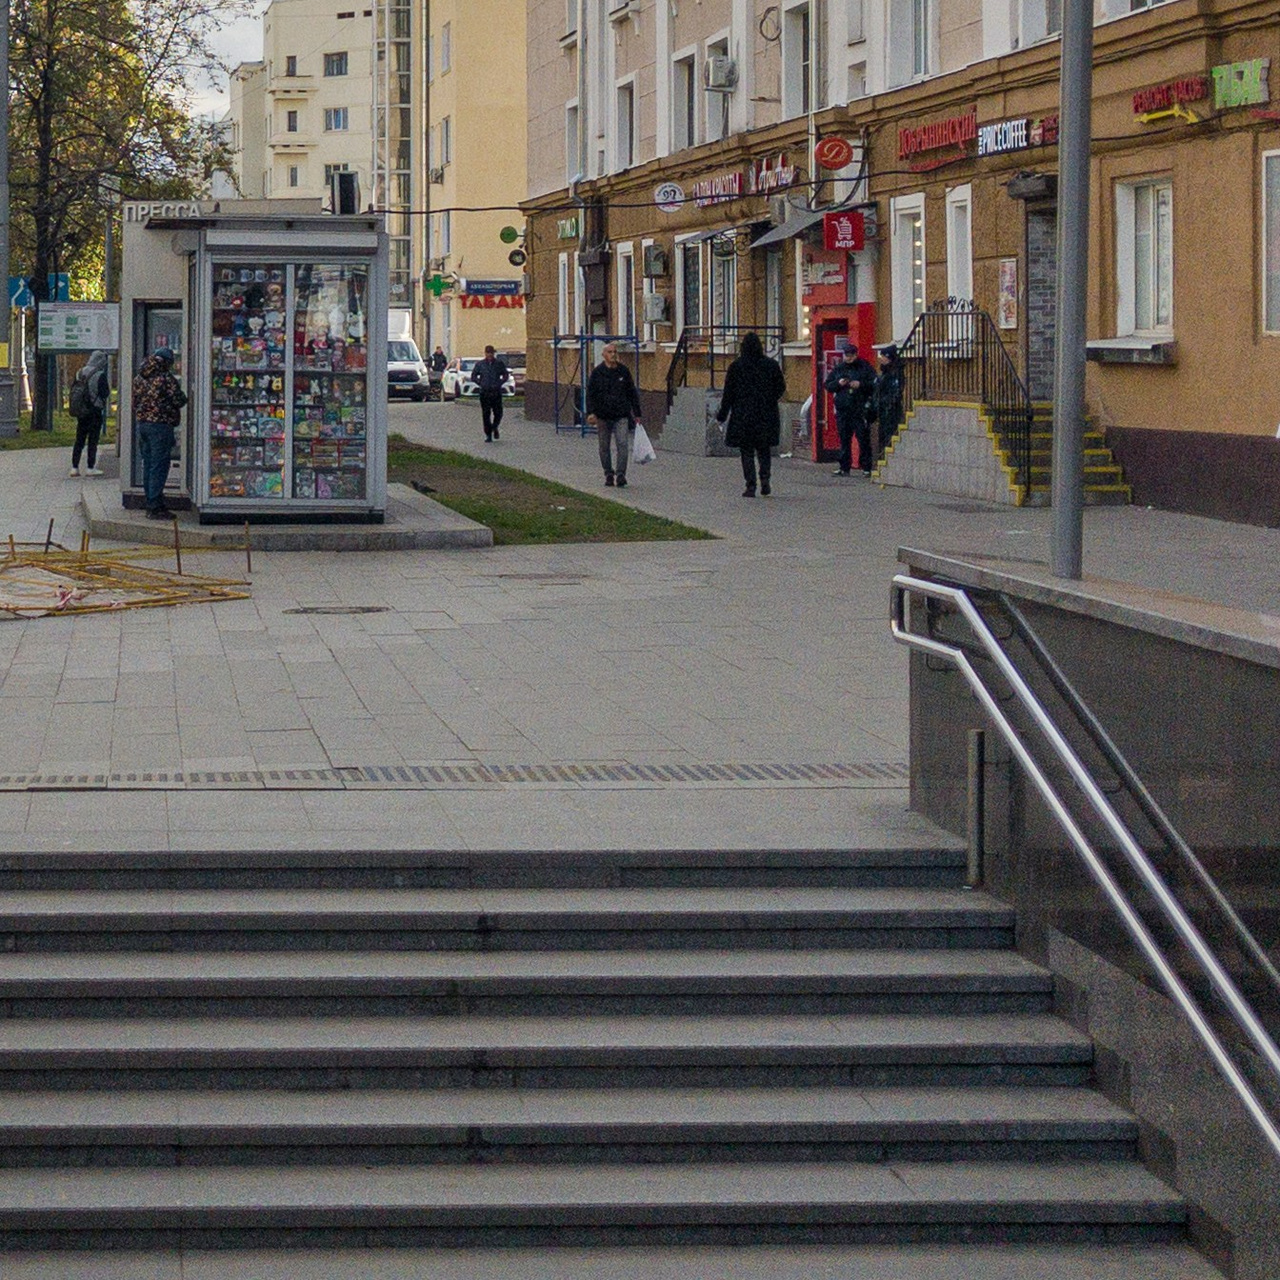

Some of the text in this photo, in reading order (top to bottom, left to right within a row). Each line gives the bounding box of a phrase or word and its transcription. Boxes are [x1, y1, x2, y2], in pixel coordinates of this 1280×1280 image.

[1212, 58, 1270, 109] ТАБАК
[125, 202, 200, 221] ПРЕССА
[458, 294, 524, 309] ТАБАК
